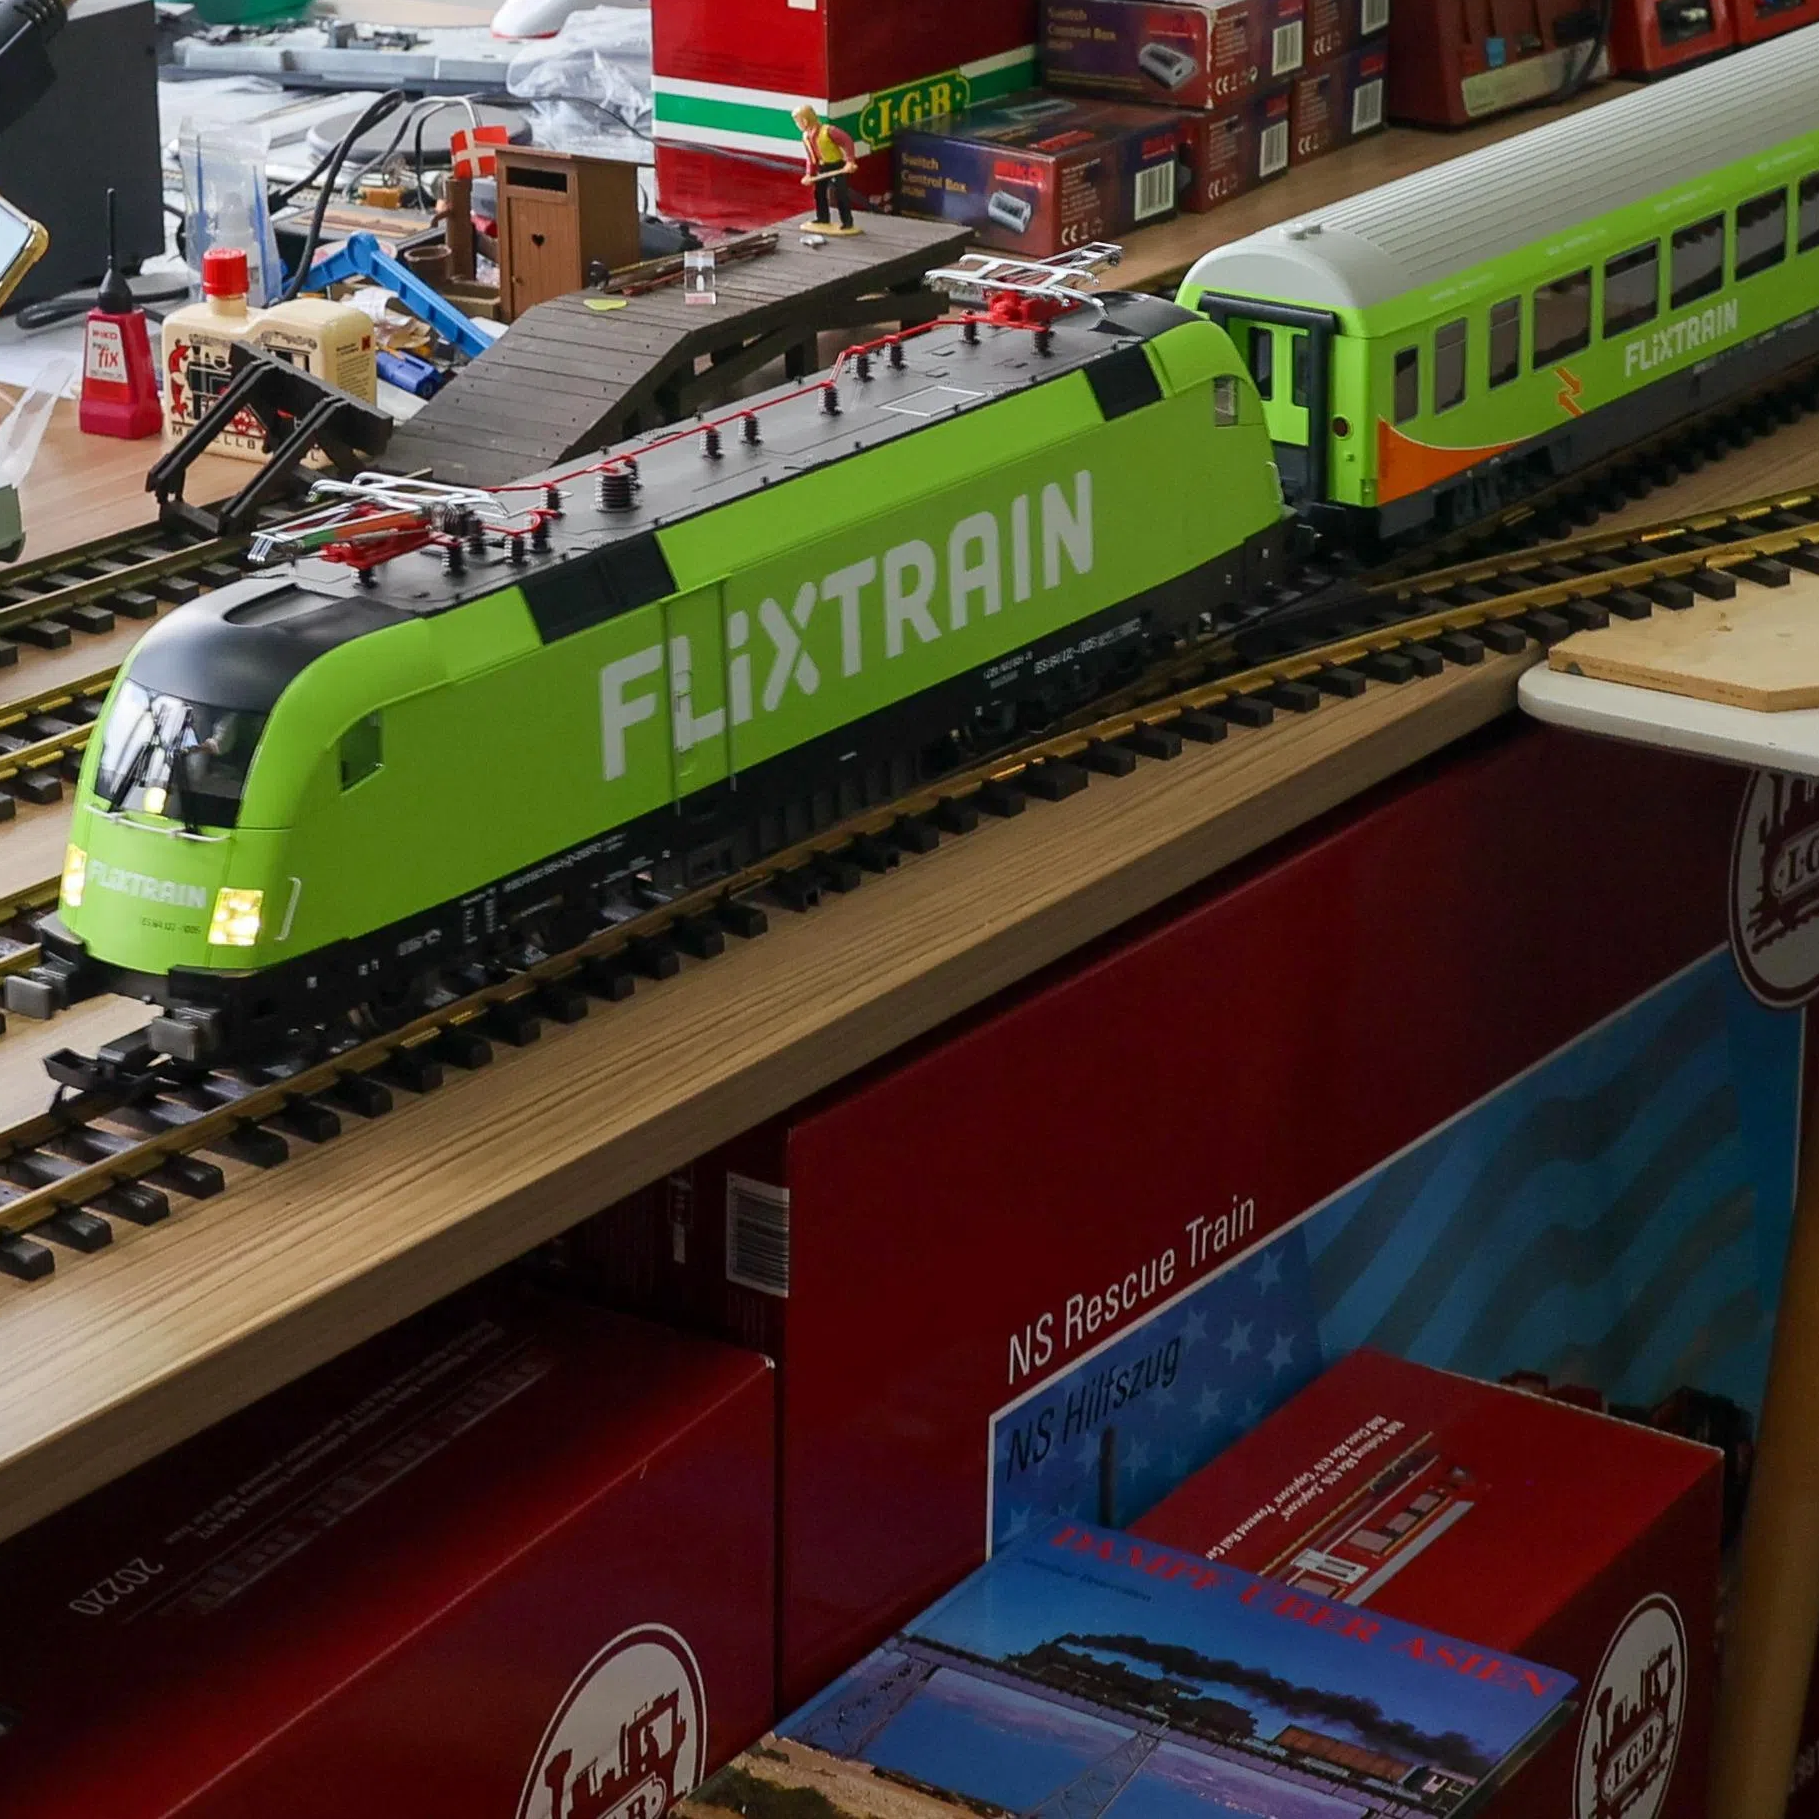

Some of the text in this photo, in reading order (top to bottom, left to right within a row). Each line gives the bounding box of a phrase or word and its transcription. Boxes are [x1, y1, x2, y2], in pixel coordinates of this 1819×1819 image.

[1008, 1193, 1255, 1386] NS Rescue Train
[1006, 1334, 1181, 1483] NS Hilfszug
[69, 1557, 166, 1615] 20220
[1049, 1524, 1232, 1591] DAMPF
[1390, 1634, 1559, 1698] ASIEN
